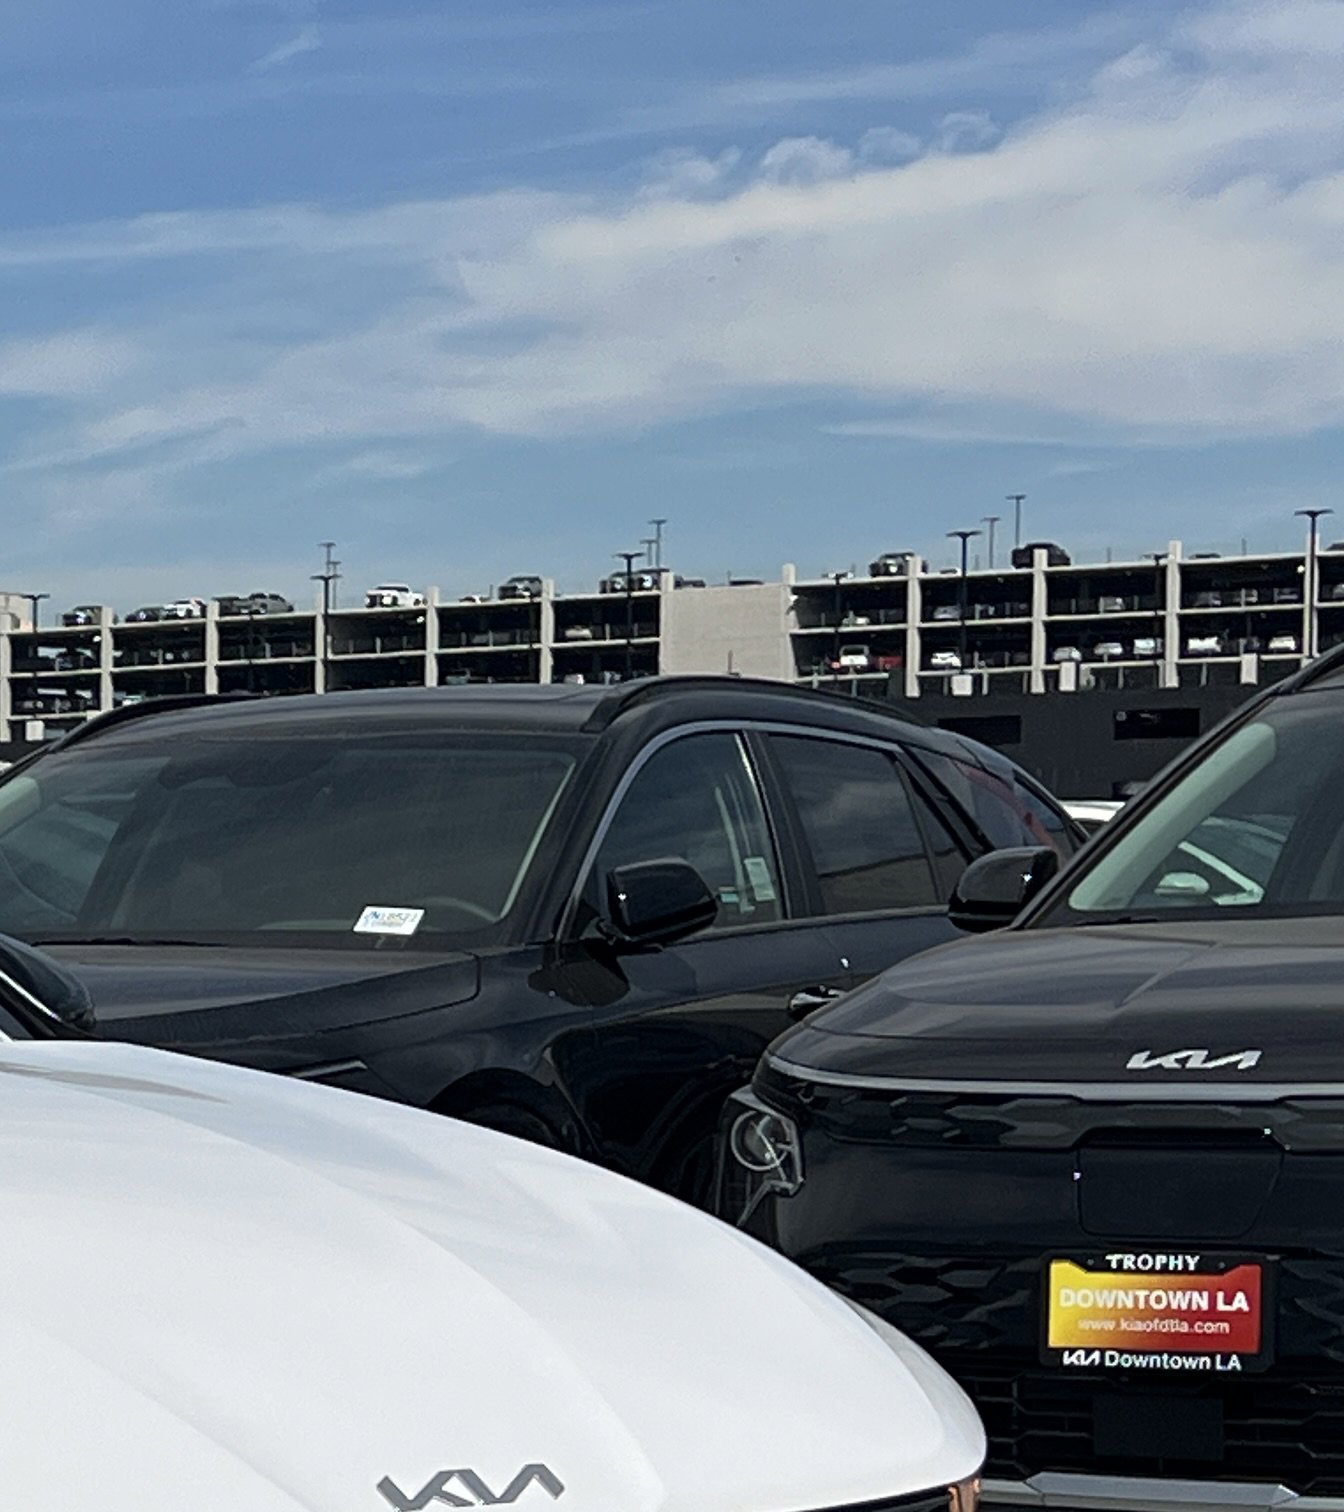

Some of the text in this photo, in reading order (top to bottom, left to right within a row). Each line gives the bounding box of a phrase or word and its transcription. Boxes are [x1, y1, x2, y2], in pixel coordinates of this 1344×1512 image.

[1126, 1050, 1262, 1069] KIA
[1106, 1254, 1200, 1271] TROPHY
[1059, 1289, 1250, 1312] DOWNTOWN LA
[1105, 1351, 1211, 1370] Downtown
[1215, 1354, 1242, 1371] LA
[376, 1463, 565, 1512] KIA
